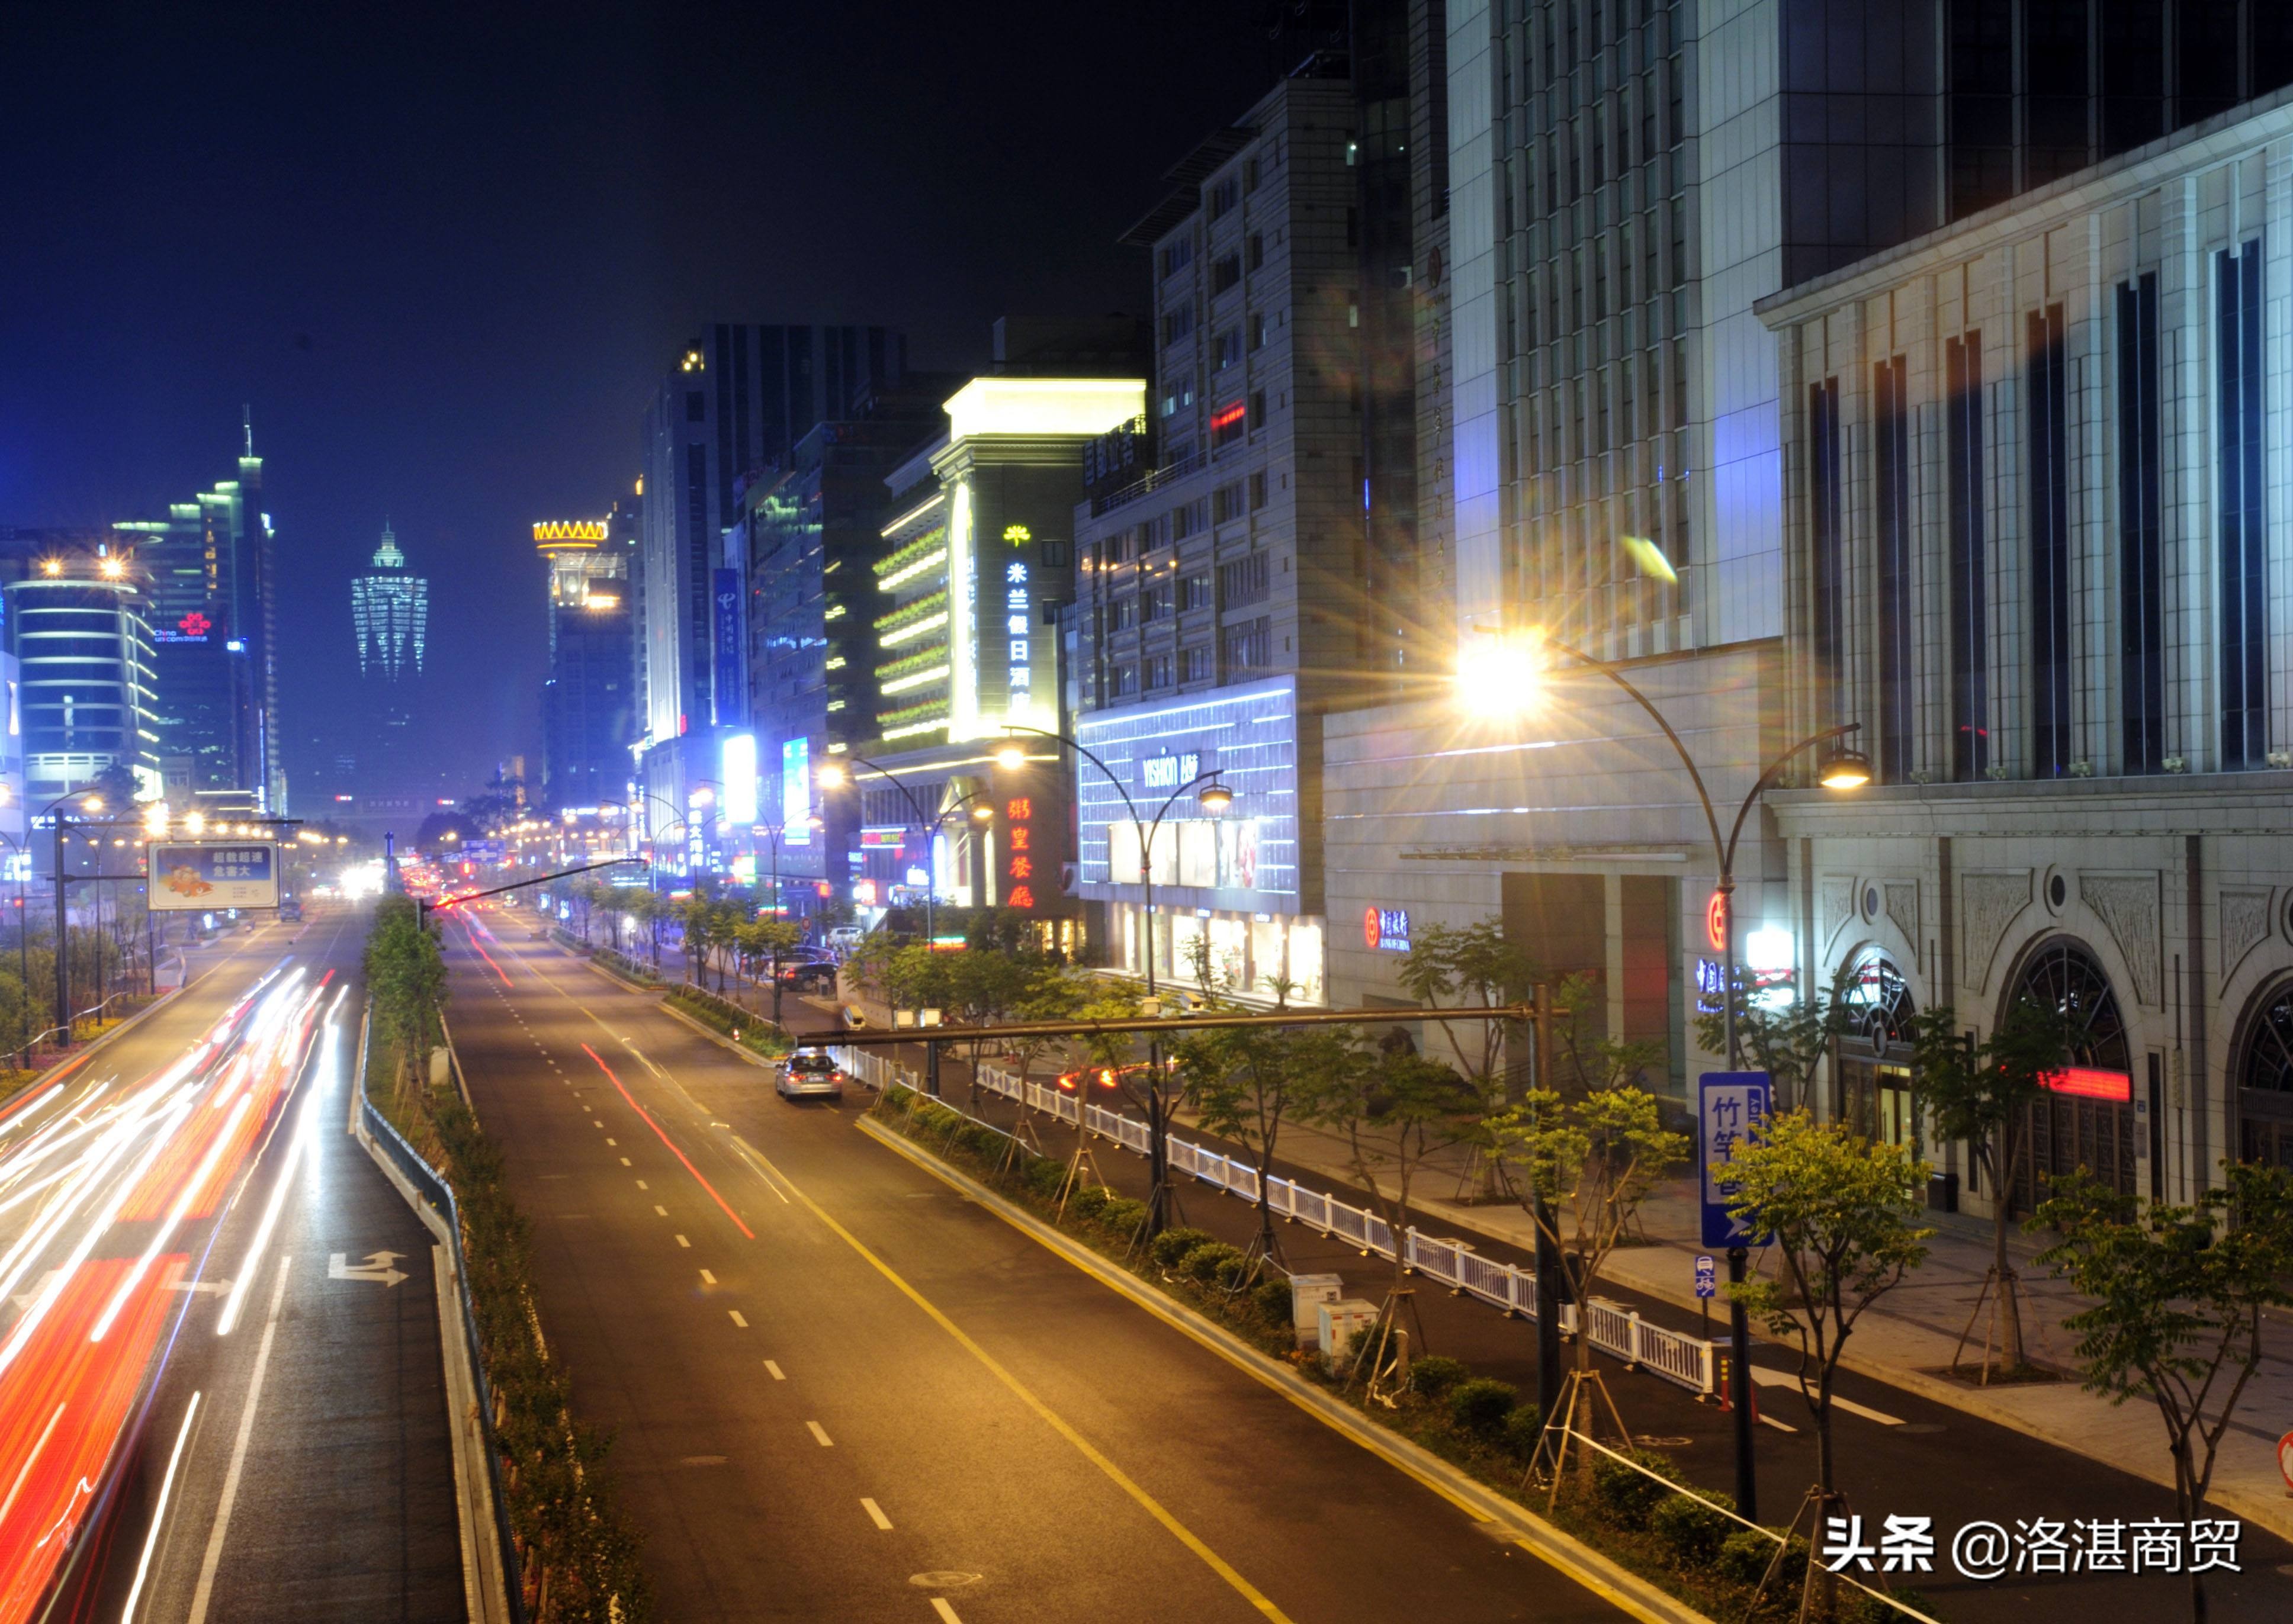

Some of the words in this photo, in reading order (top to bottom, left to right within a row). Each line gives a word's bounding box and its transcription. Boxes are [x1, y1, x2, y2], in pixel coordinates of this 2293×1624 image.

[213, 851, 263, 863] 超载超速
[213, 865, 251, 877] 危害大
